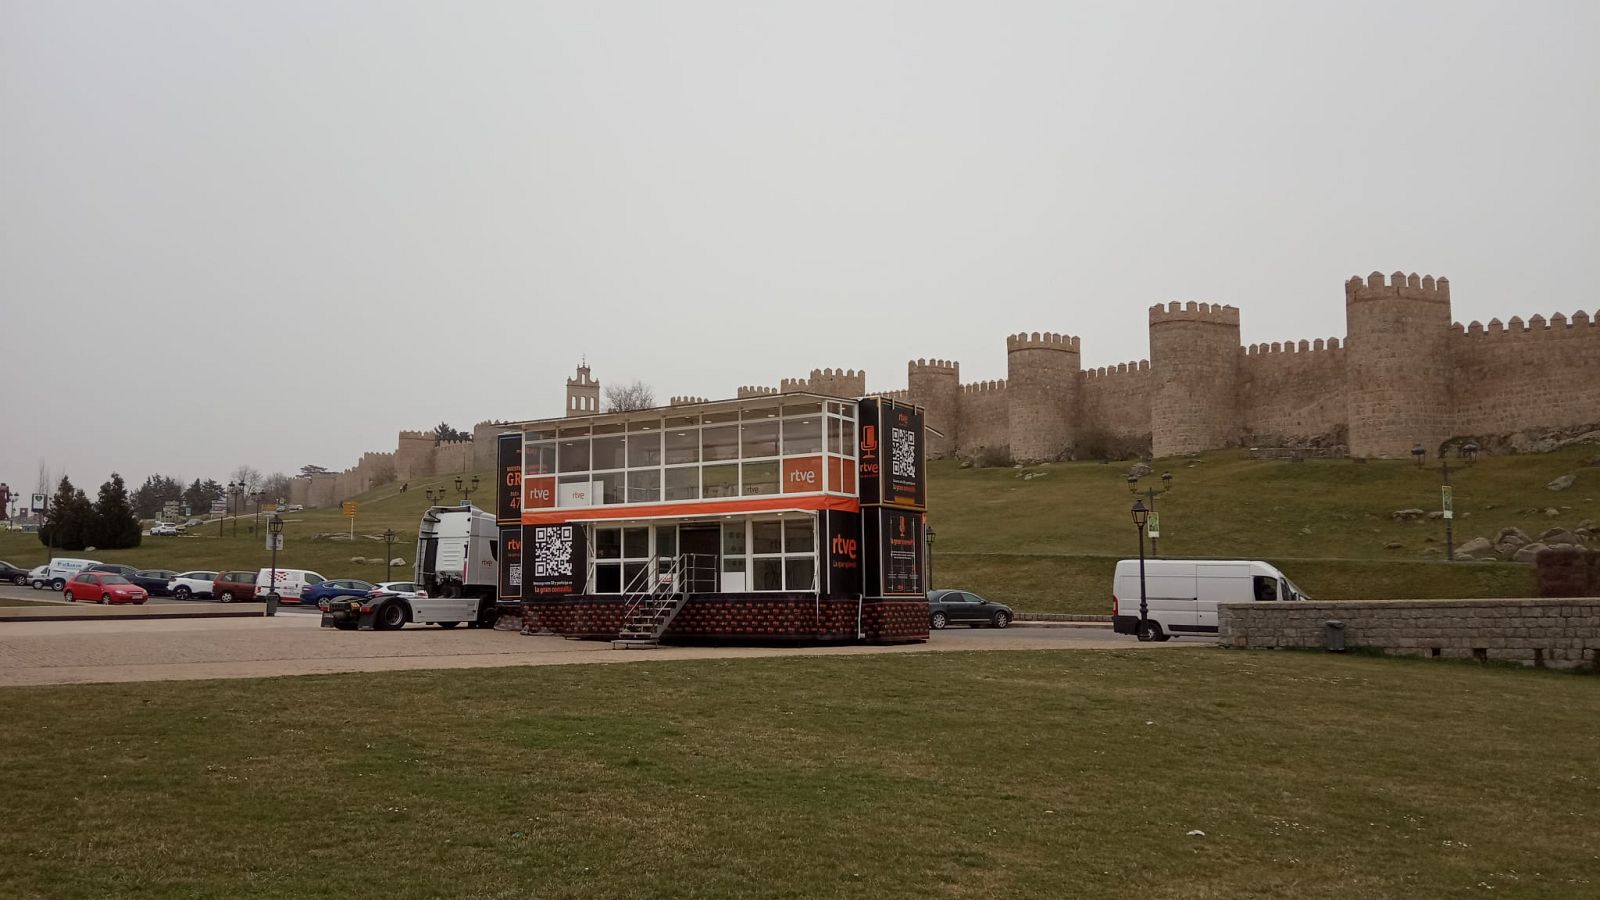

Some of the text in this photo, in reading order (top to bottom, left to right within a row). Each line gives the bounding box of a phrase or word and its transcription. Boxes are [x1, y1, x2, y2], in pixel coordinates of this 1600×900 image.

[860, 462, 879, 473] rtve
[790, 469, 815, 483] rtve
[530, 488, 550, 500] rtve
[572, 490, 585, 500] rtve
[747, 484, 759, 494] rtve
[508, 538, 522, 550] rtv
[832, 534, 857, 559] rtve
